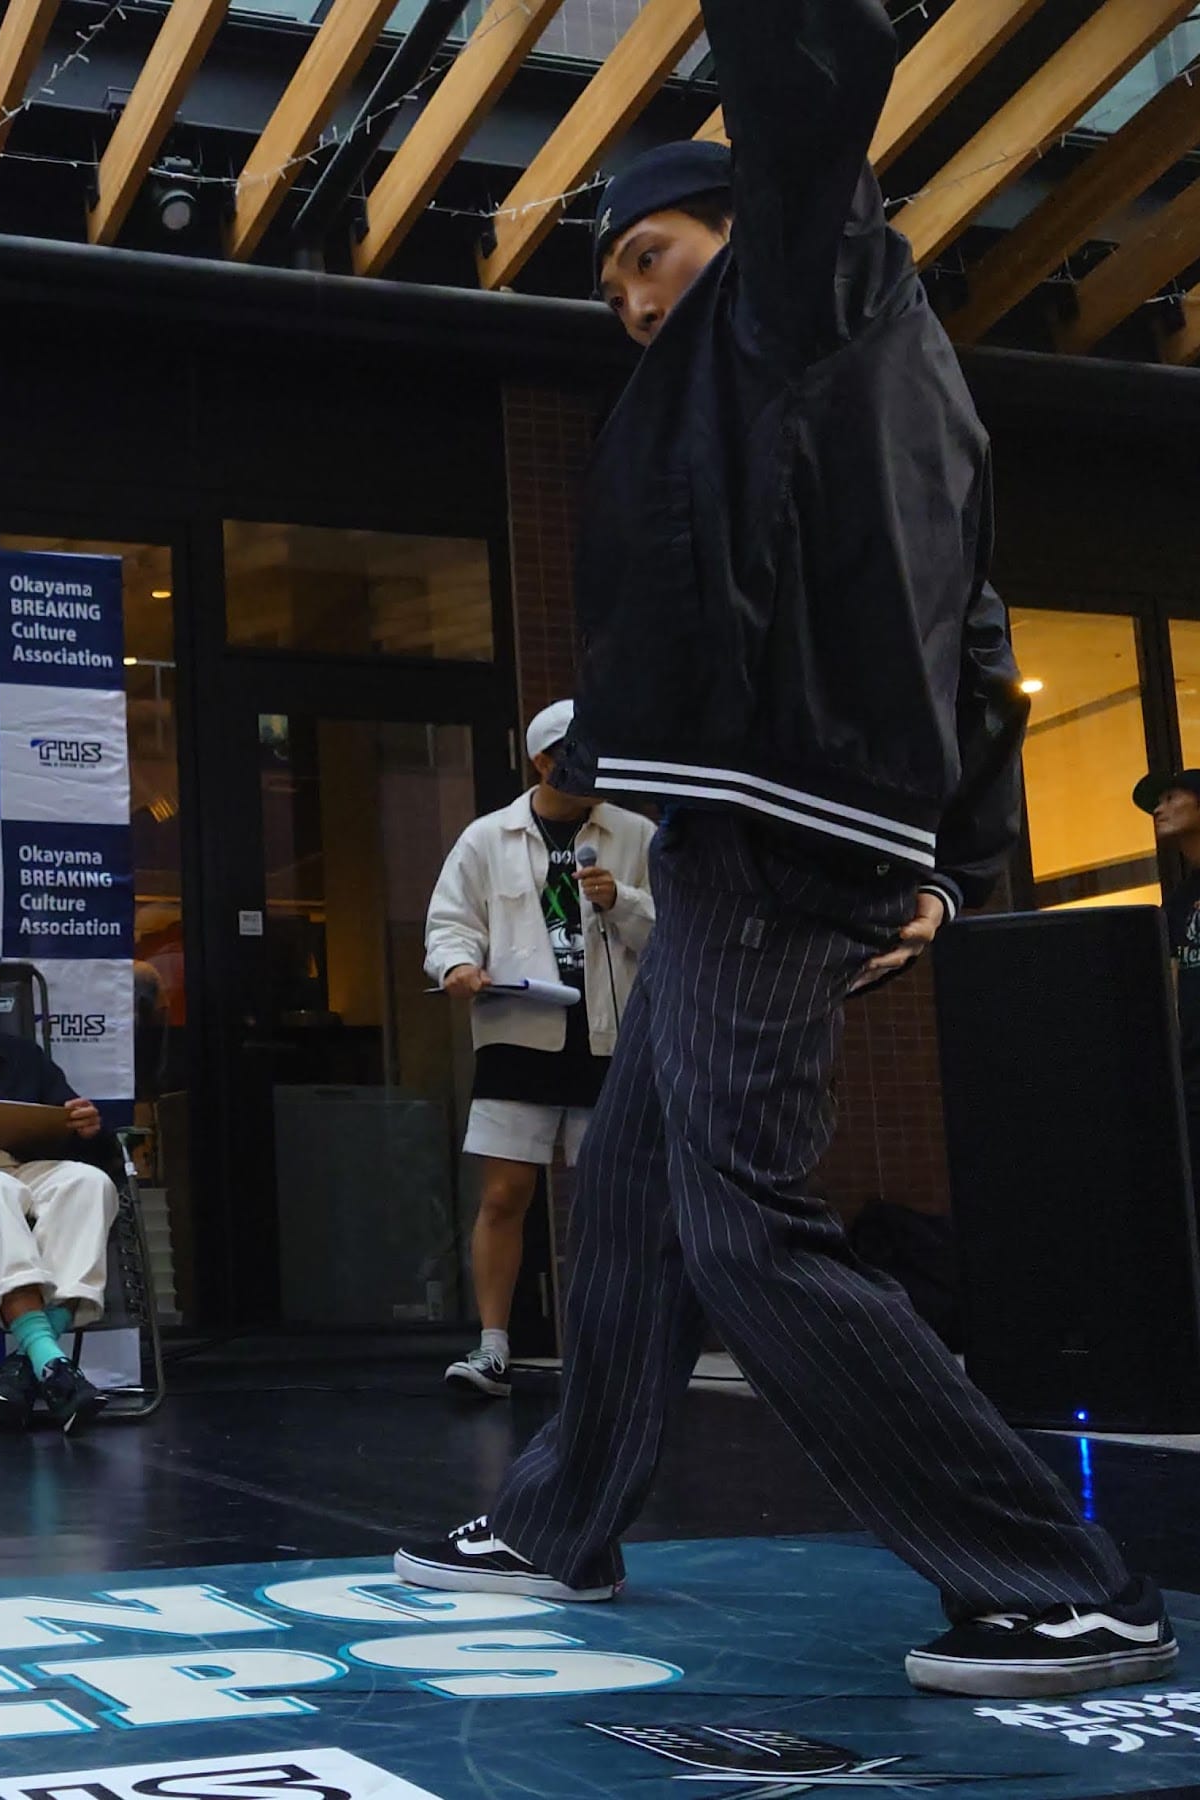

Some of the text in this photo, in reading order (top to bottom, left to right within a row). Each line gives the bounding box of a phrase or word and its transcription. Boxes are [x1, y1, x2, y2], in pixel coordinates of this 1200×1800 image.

[10, 575, 92, 598] Okayama
[10, 598, 101, 620] BREAKING
[11, 622, 76, 642] Culture
[13, 645, 113, 668] Association
[30, 739, 101, 762] THS
[19, 845, 102, 867] Okayama
[20, 869, 112, 888] BREAKING
[20, 893, 86, 911] Culture
[19, 917, 120, 936] Association
